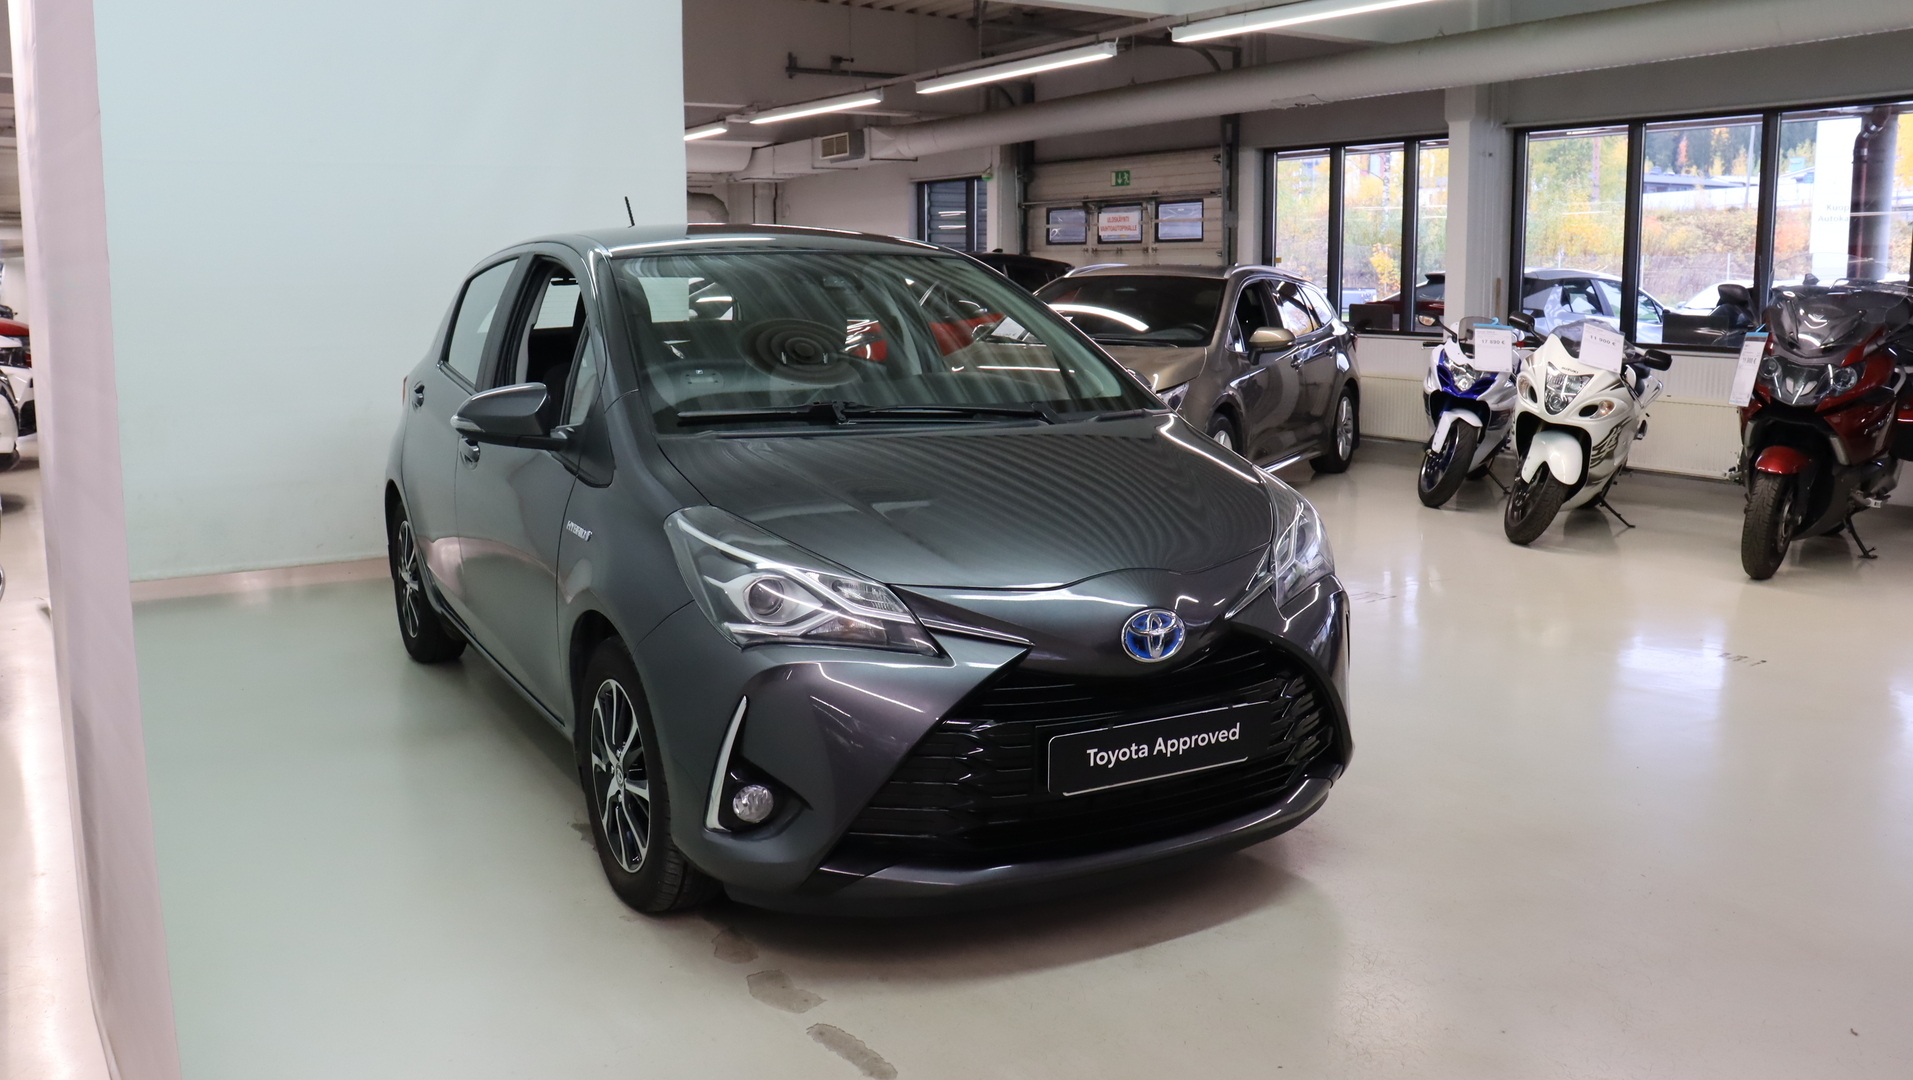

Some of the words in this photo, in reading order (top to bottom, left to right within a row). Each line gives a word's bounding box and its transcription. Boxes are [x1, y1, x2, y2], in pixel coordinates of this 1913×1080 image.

[566, 520, 587, 539] HYBRID
[1086, 743, 1149, 768] Toyota
[1153, 722, 1240, 757] Approved
